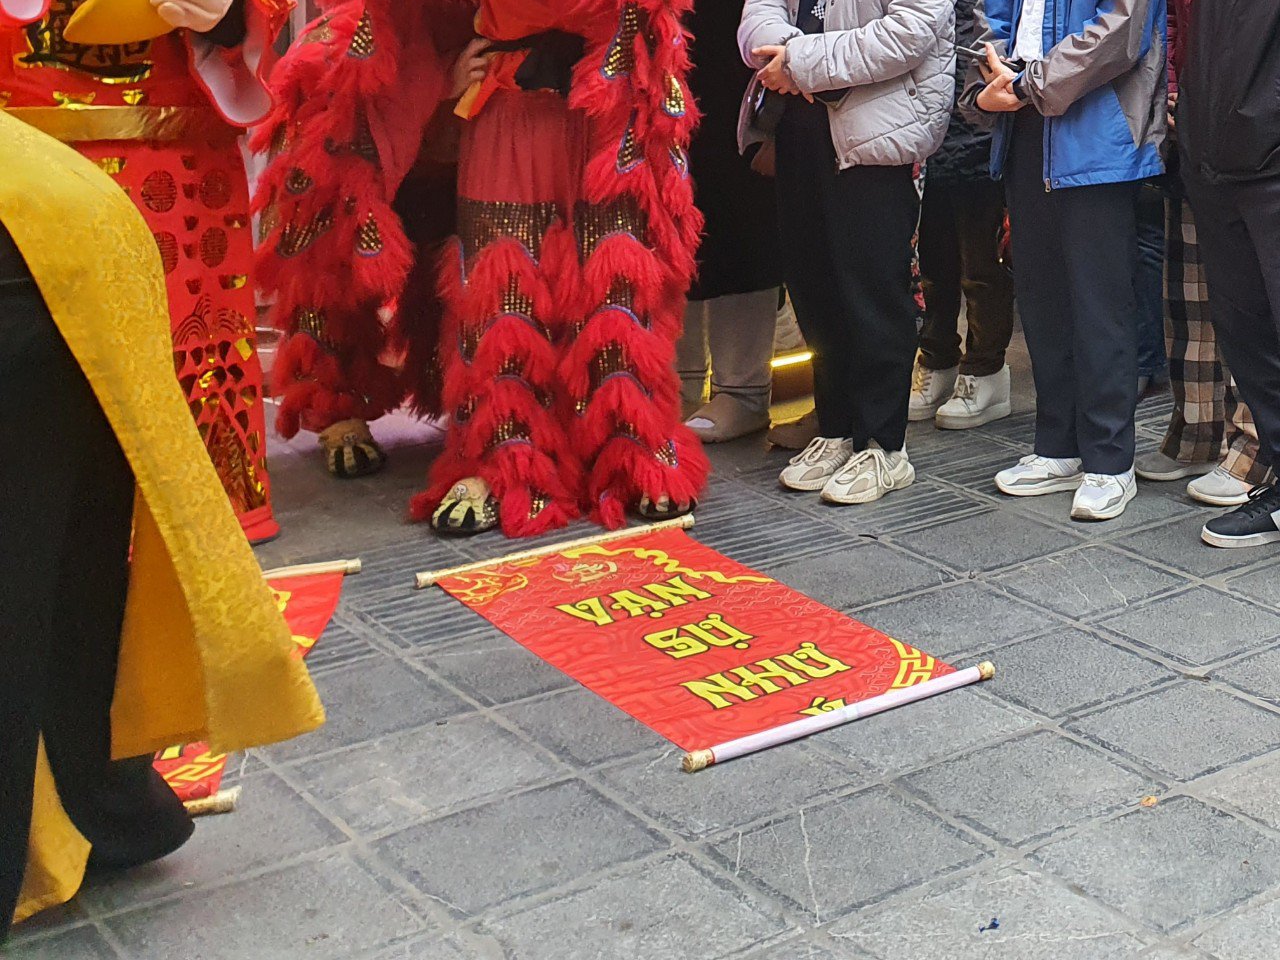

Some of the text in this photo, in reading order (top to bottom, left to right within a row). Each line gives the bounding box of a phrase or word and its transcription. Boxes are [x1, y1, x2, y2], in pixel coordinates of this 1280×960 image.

[555, 574, 714, 628] VẠN
[642, 612, 757, 659] SỰ
[681, 640, 852, 710] NHƯ
